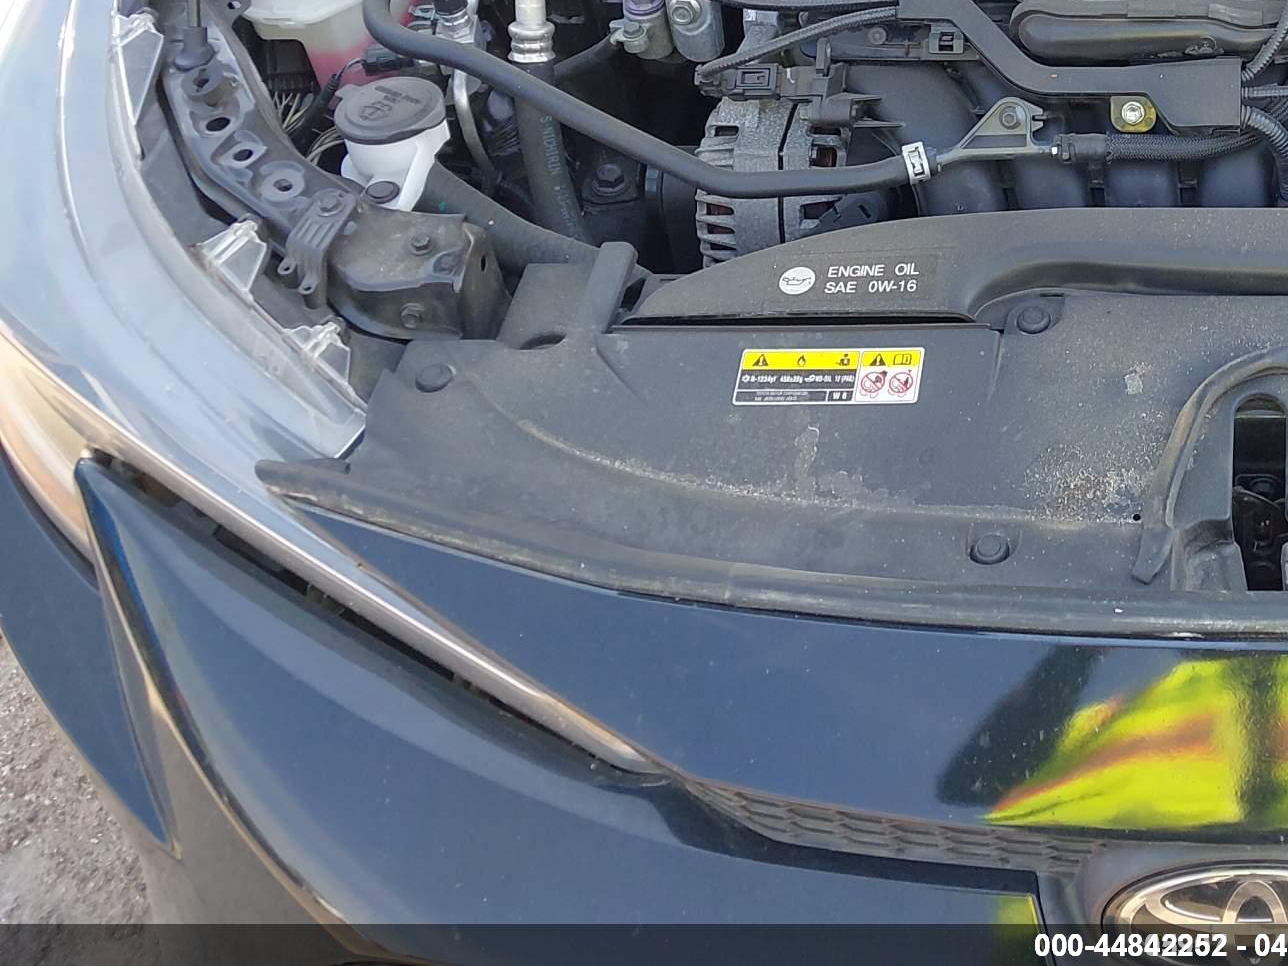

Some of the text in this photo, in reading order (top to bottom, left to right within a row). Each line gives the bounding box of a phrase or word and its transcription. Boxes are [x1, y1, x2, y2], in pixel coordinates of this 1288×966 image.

[827, 263, 920, 278] ENGINE OIL
[824, 279, 917, 294] SAE 0W-16
